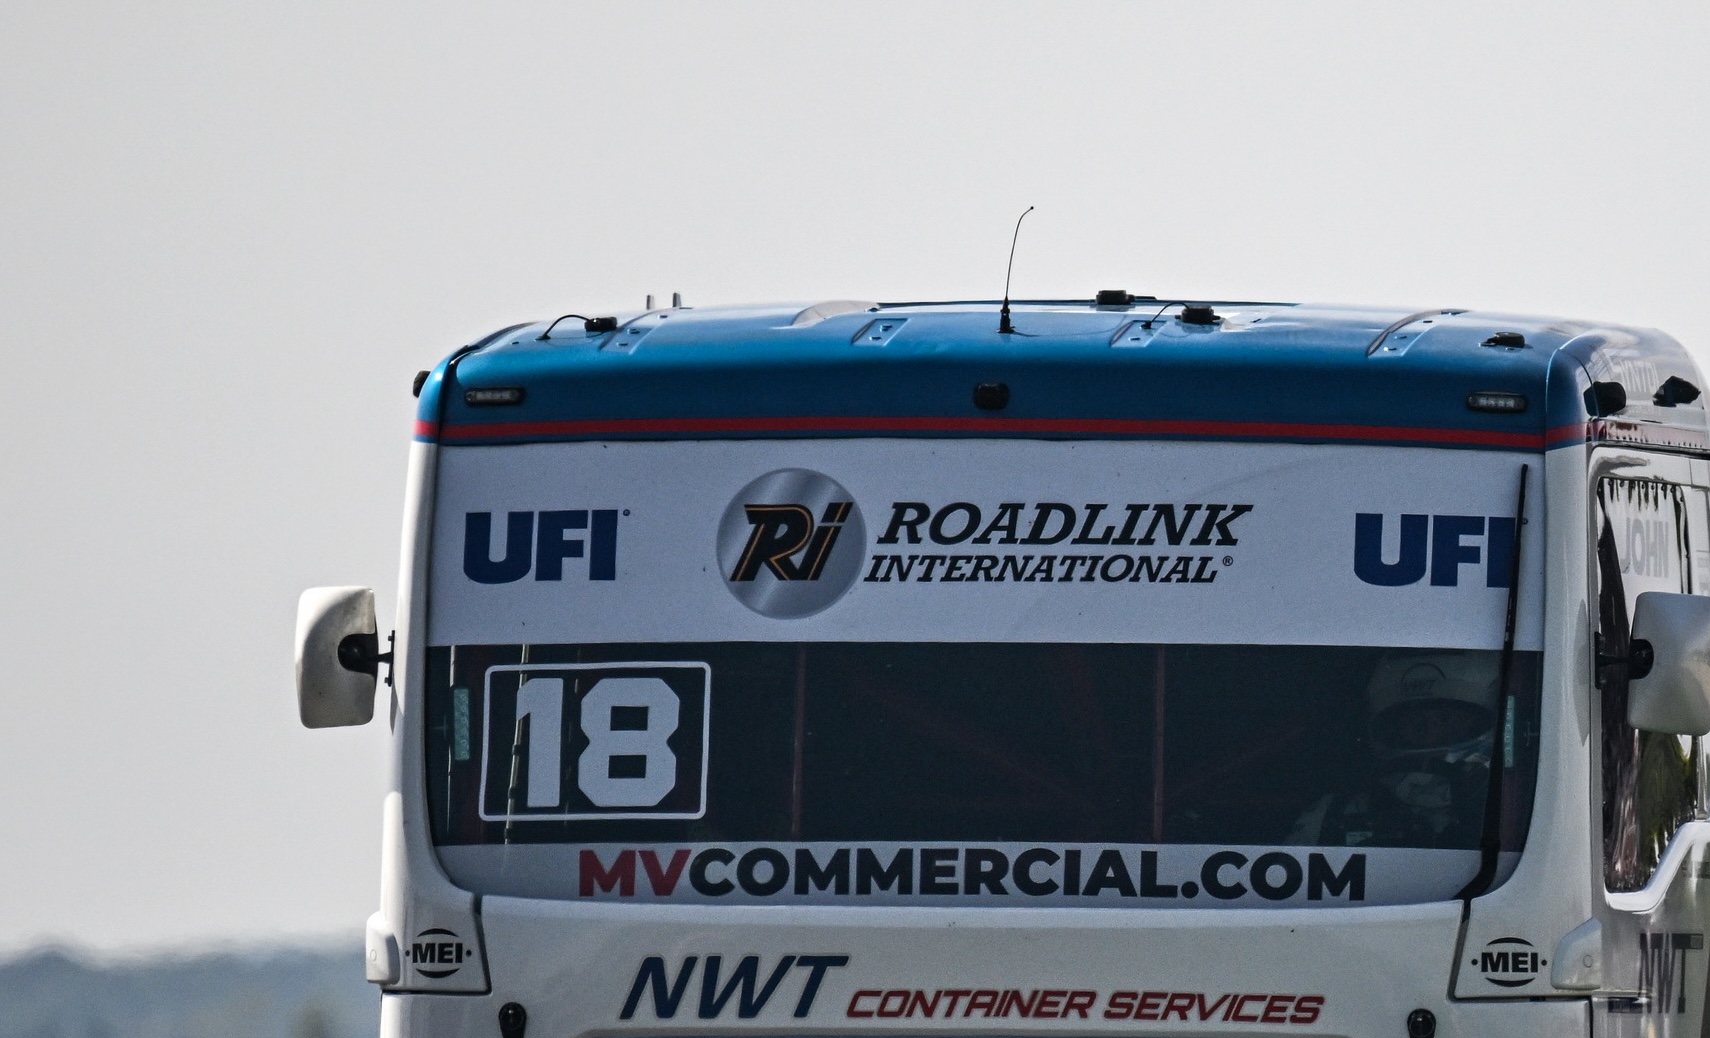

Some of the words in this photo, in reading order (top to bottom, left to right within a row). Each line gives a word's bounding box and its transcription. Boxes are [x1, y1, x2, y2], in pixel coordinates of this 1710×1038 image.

[463, 509, 619, 584] UFI
[876, 502, 1254, 546] ROADLINK
[1354, 513, 1518, 587] UFI
[1619, 517, 1669, 579] JOHN
[516, 677, 680, 807] 18
[579, 848, 1366, 901] MVCOMMERCIAL.COM
[412, 941, 464, 965] MEI
[1481, 952, 1539, 973] MEI
[1638, 933, 1700, 1013] NWT
[620, 955, 849, 1020] NWT
[847, 989, 1096, 1019] CONTAINER
[1104, 992, 1327, 1024] SERVICES
